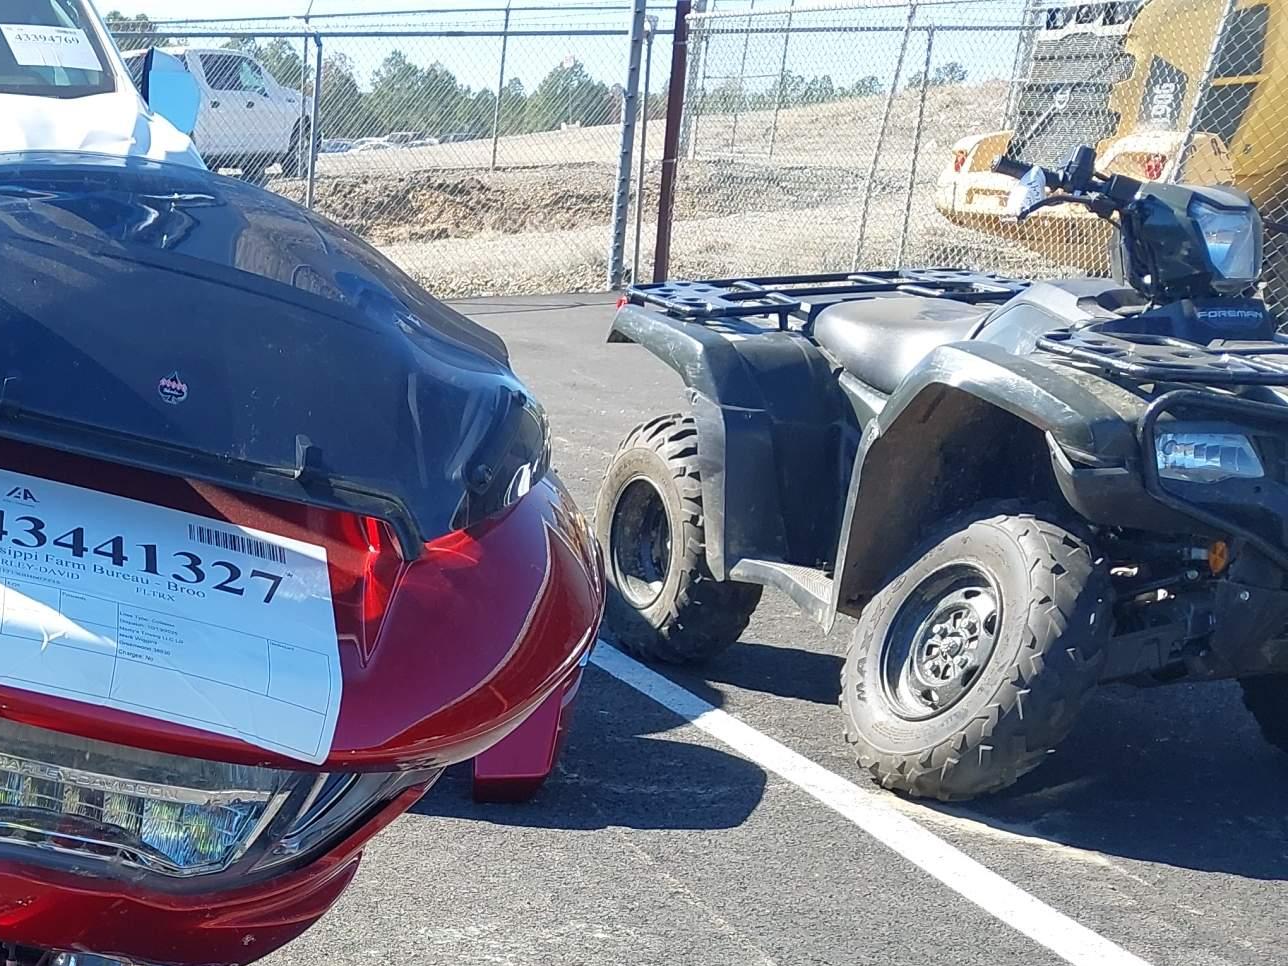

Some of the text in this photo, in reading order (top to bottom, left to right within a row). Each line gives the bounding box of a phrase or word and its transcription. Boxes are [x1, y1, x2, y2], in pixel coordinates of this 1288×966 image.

[1197, 309, 1263, 319] FOREMAN
[45, 553, 86, 571] Farm
[93, 564, 149, 585] Bureau
[167, 581, 206, 599] Broo
